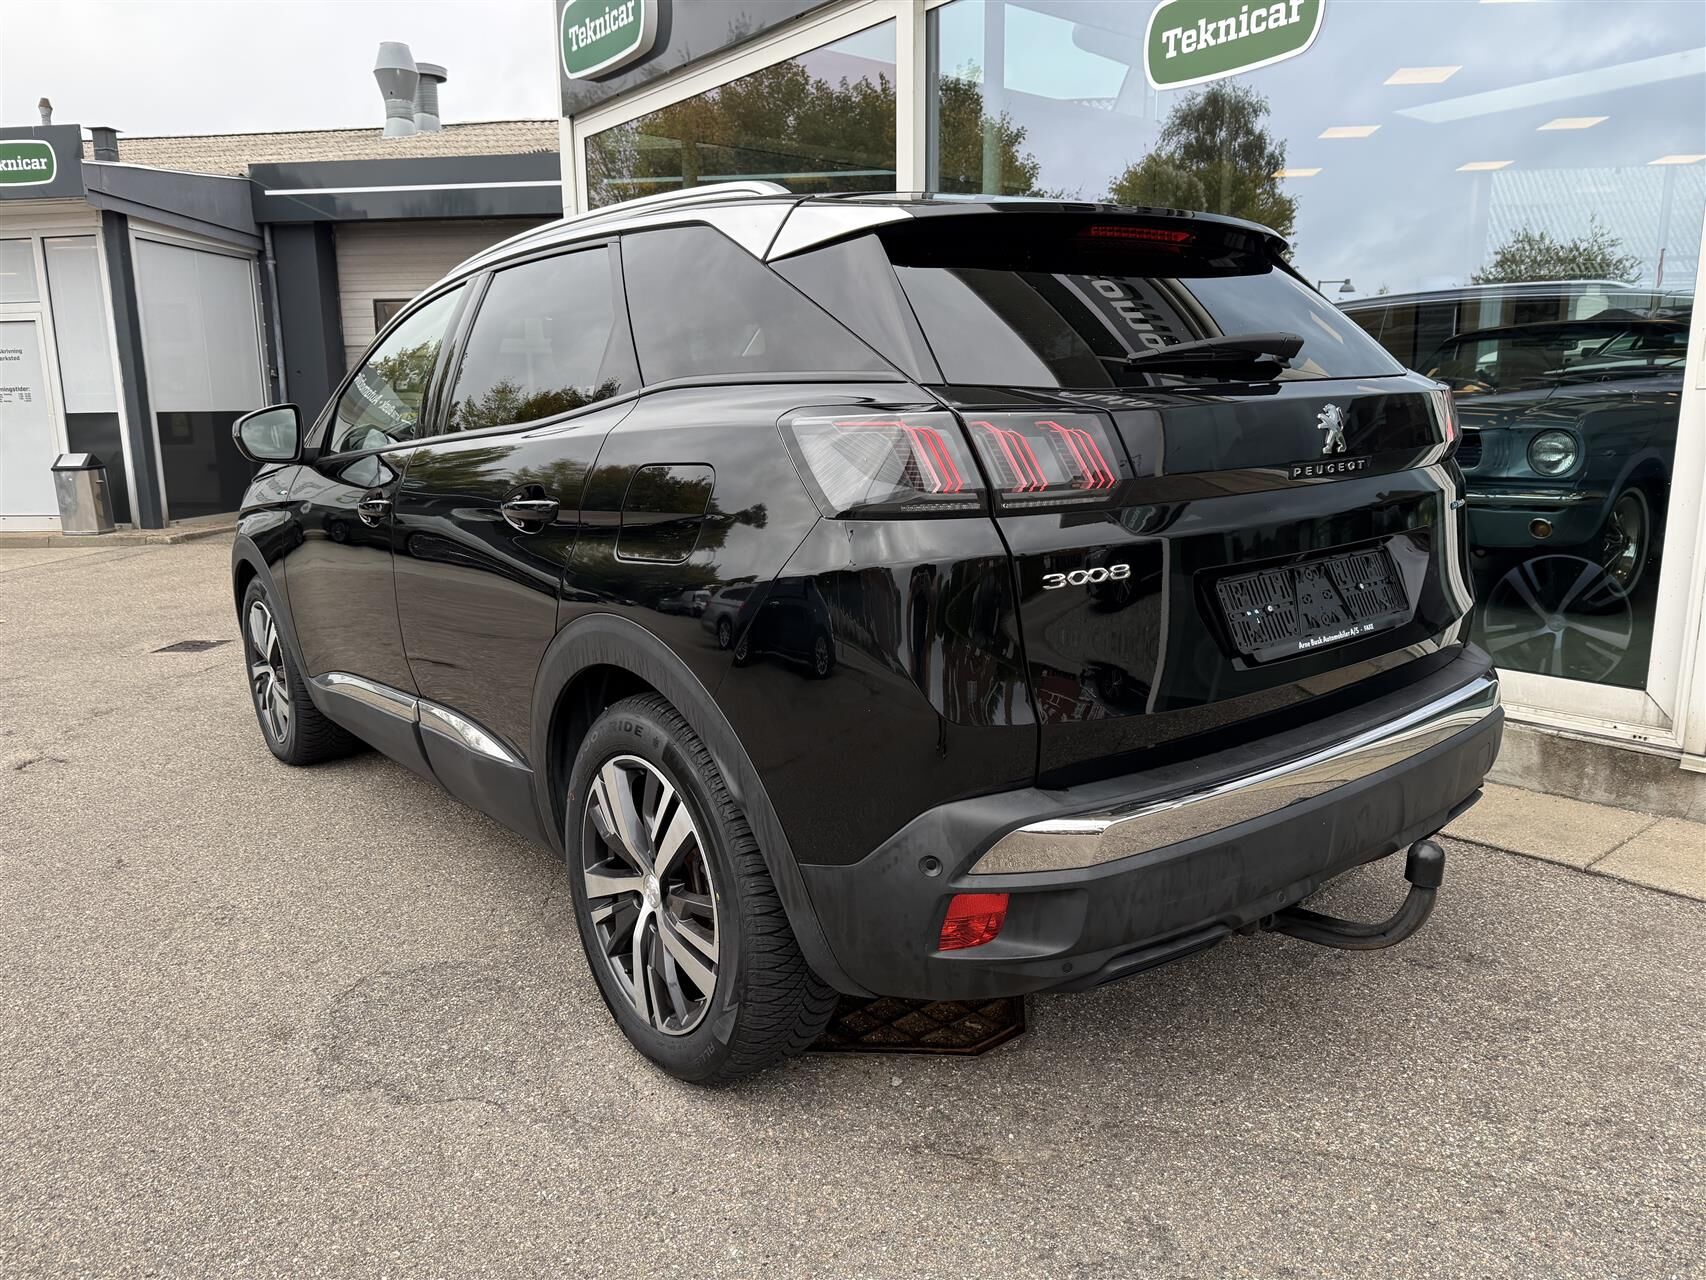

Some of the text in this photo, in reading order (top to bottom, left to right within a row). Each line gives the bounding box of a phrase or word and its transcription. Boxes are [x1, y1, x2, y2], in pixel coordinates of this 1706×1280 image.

[568, 0, 635, 52] Teknicar
[1162, 0, 1303, 59] Teknicar
[1293, 459, 1366, 478] PEUGEOT
[1042, 564, 1131, 590] 3008
[1298, 641, 1310, 649] Arne
[1311, 636, 1323, 646] Busk
[1323, 630, 1350, 643] Automobiler
[1350, 627, 1360, 636] A/S
